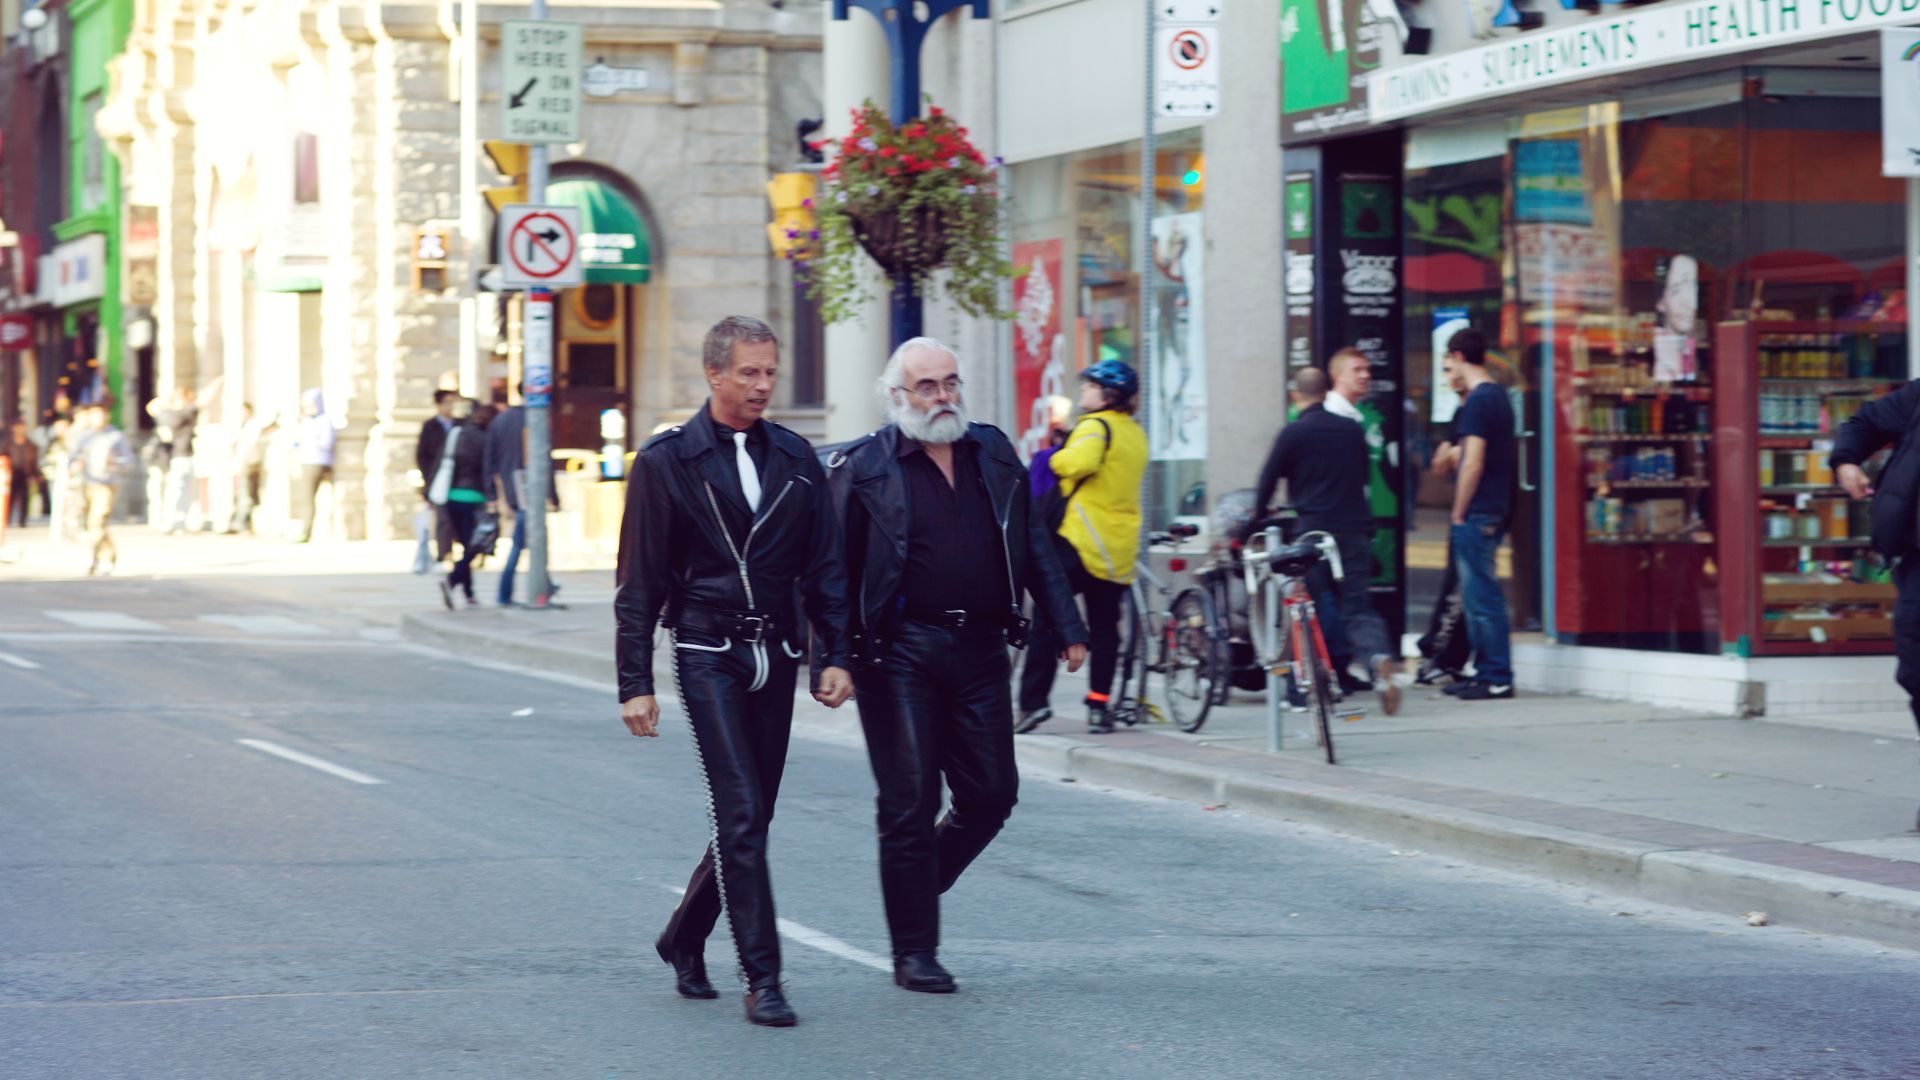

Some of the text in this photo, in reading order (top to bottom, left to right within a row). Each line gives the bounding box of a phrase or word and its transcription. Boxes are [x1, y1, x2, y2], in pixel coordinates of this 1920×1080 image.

[517, 28, 567, 45] STOP
[1483, 20, 1638, 87] SUPPLEMENTS
[1686, 0, 1800, 47] HEALTH
[516, 51, 567, 68] HERE
[551, 75, 571, 91] ON
[540, 97, 572, 113] RED
[511, 118, 571, 136] SIGNAL
